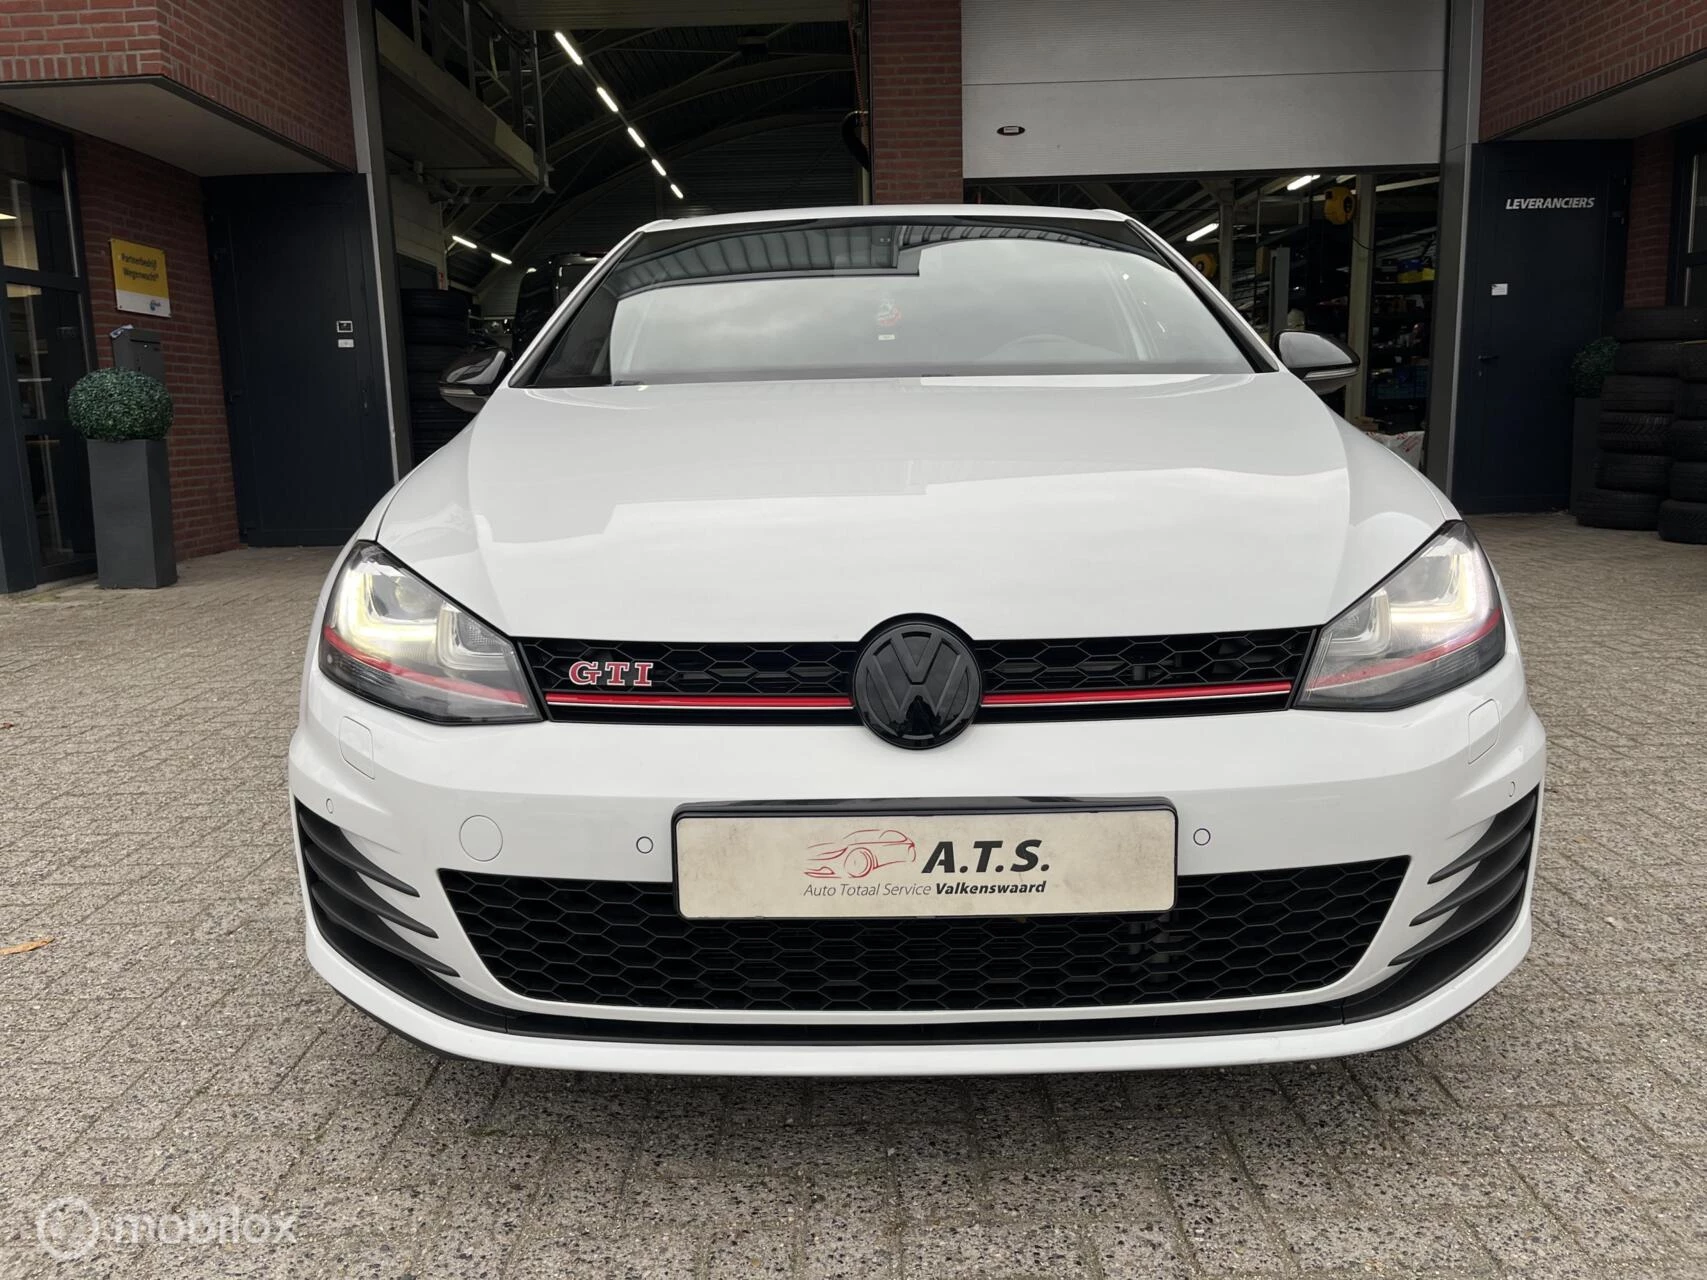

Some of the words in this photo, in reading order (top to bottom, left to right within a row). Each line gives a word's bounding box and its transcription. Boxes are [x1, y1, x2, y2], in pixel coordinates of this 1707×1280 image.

[1505, 197, 1596, 210] LEVERANCIERS
[568, 660, 654, 687] GTI
[921, 839, 1050, 874] A.T.S.
[803, 883, 837, 897] Auto
[840, 882, 880, 897] Totaal
[883, 882, 931, 896] Service
[935, 880, 1047, 896] Valkenswaard
